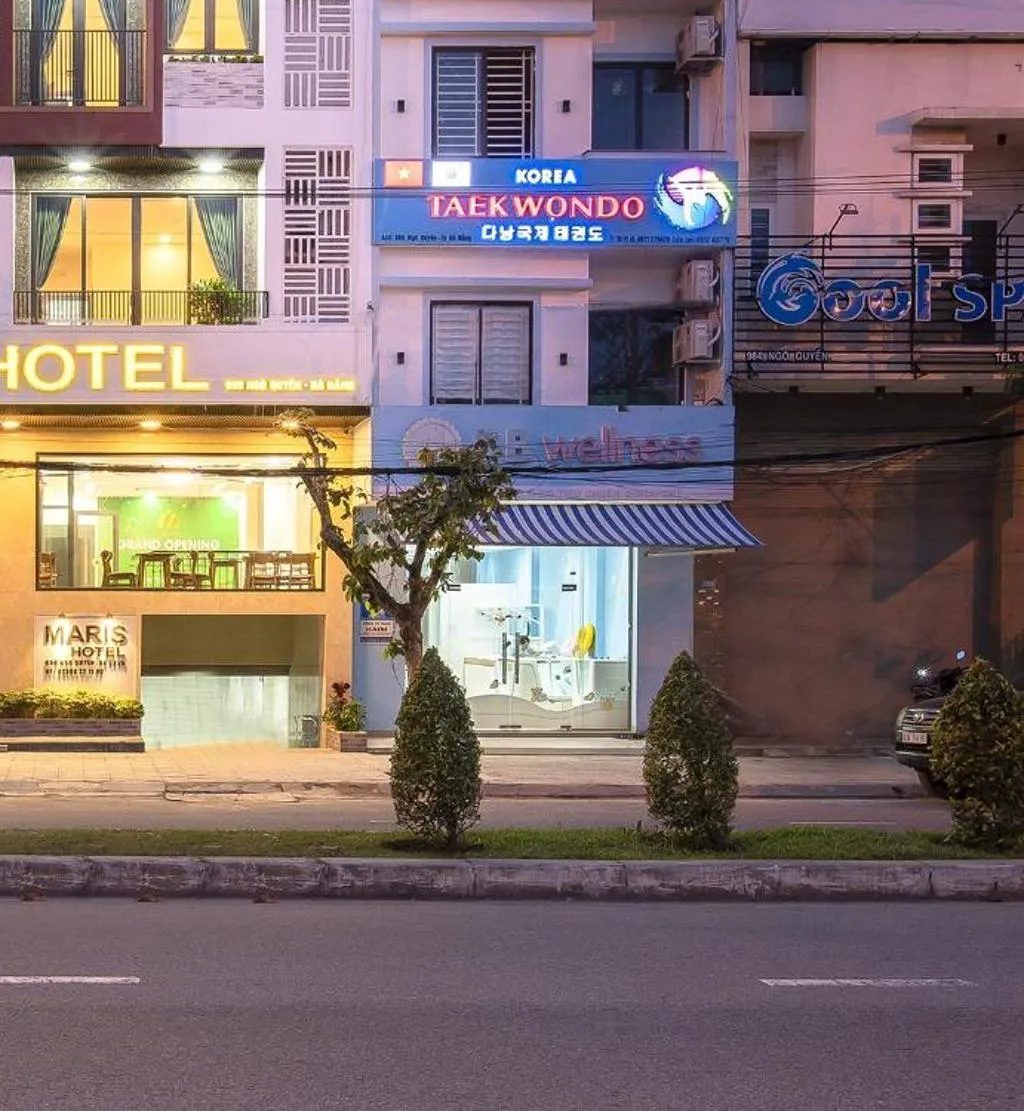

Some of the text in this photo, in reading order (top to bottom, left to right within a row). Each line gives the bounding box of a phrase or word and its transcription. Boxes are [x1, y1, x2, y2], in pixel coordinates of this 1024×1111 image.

[515, 168, 578, 185] KOREA
[542, 423, 704, 463] wellness
[164, 538, 220, 550] OPENING
[43, 624, 128, 645] MARIS
[70, 646, 125, 658] HOTEL
